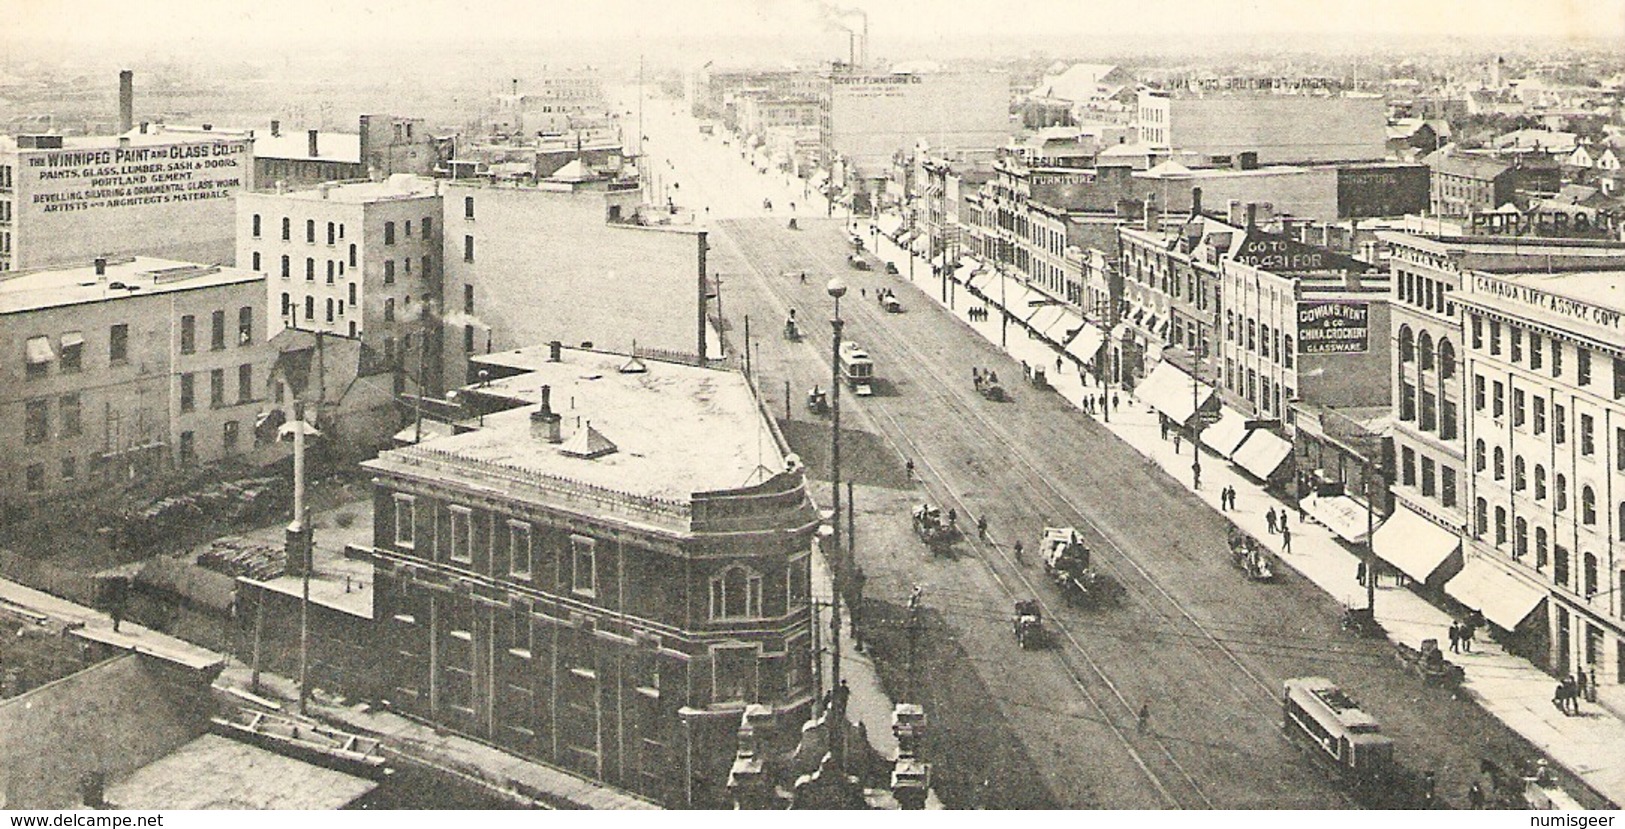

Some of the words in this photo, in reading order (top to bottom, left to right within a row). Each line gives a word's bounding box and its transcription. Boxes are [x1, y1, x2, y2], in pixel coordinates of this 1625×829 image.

[29, 158, 45, 167] THE
[47, 151, 110, 167] WINNIPEG
[115, 149, 150, 163] PAINT
[170, 145, 209, 159] GLASS
[167, 161, 193, 171] SASH
[195, 162, 203, 170] &
[91, 175, 147, 187] PORTLAND
[1033, 174, 1095, 185] FURNITURE
[85, 188, 125, 199] SILVERING
[126, 188, 132, 196] &
[134, 183, 184, 195] ORNAMENTAL
[187, 180, 213, 190] GLASS
[43, 202, 89, 213] ARTISTS
[106, 196, 170, 208] ARCHITECTS
[1249, 241, 1267, 253] GO
[1270, 241, 1288, 252] TO
[1261, 255, 1289, 268] 431
[1293, 254, 1322, 267] FOR
[1477, 276, 1519, 300] CANADA
[1523, 288, 1547, 309] LIFE
[1343, 305, 1367, 320] KENT
[1325, 327, 1367, 339] CROCKERY
